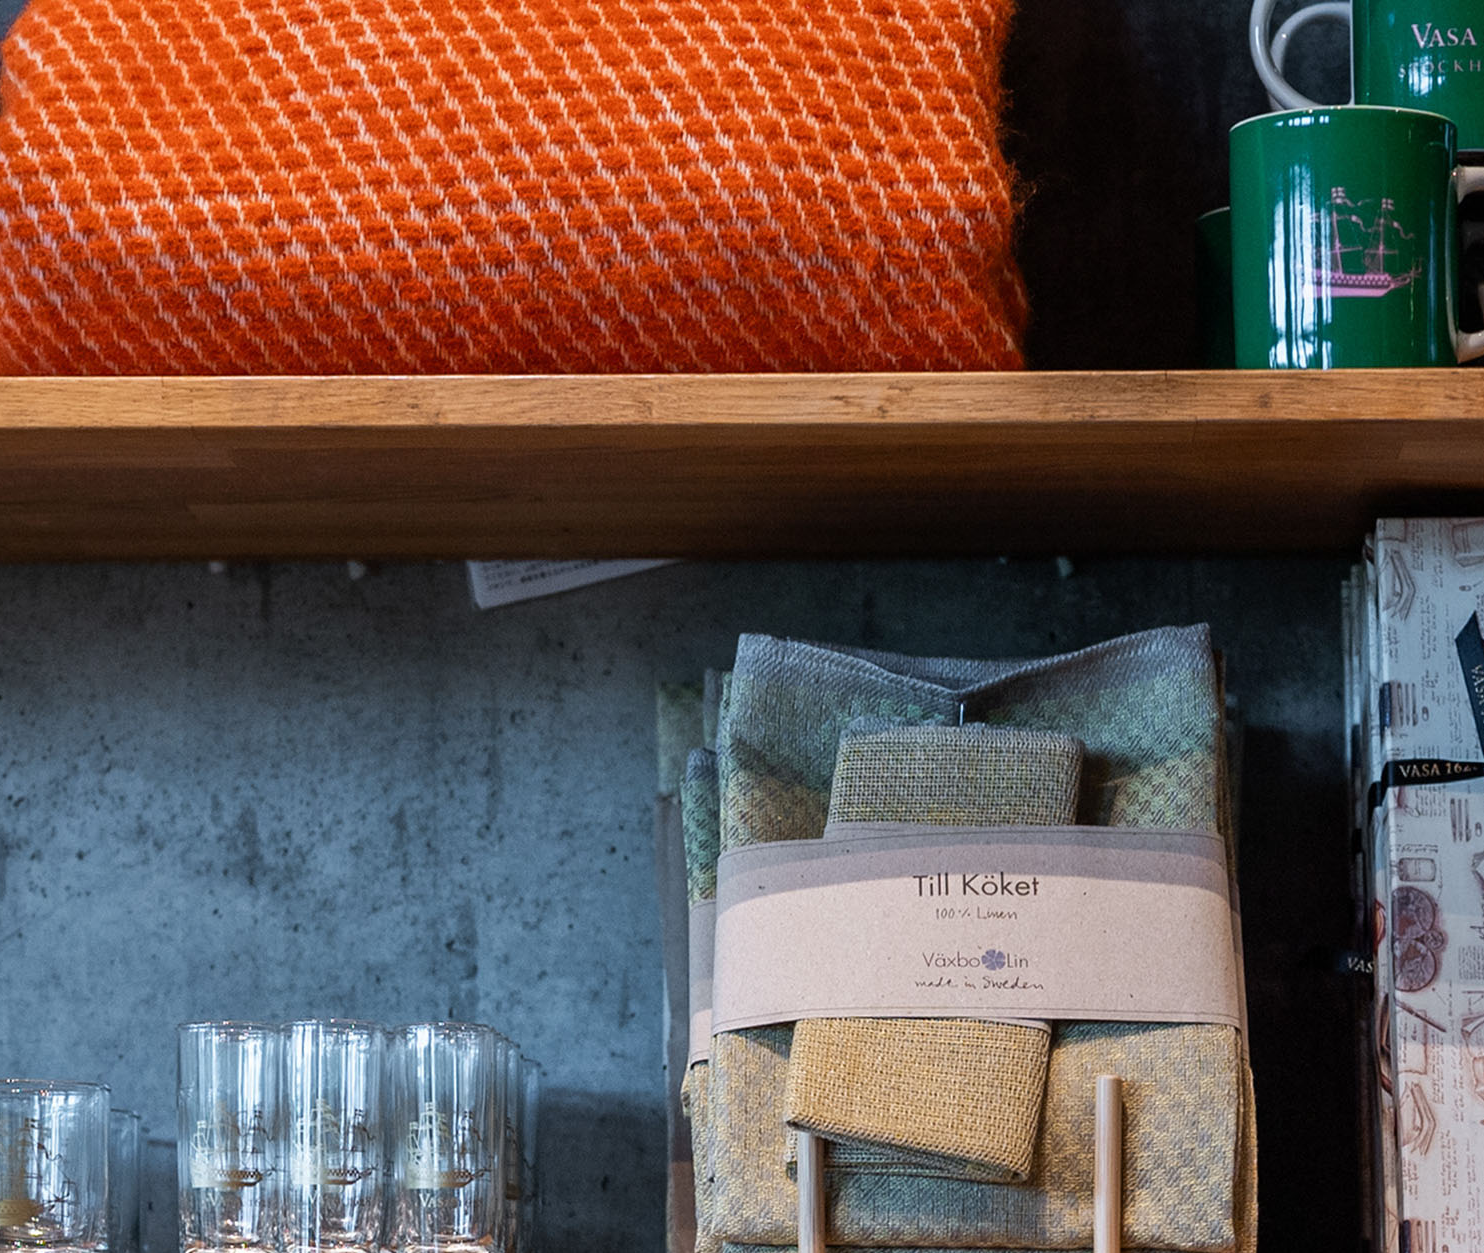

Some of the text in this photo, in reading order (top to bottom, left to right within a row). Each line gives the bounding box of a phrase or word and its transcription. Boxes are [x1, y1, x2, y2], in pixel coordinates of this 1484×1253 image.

[1411, 22, 1477, 48] VASA
[1399, 764, 1441, 778] VASA
[913, 871, 1040, 897] Till Köket
[976, 906, 1018, 920] Linen
[922, 951, 1029, 968] Växbo Lin
[915, 976, 1044, 990] made in Sweden
